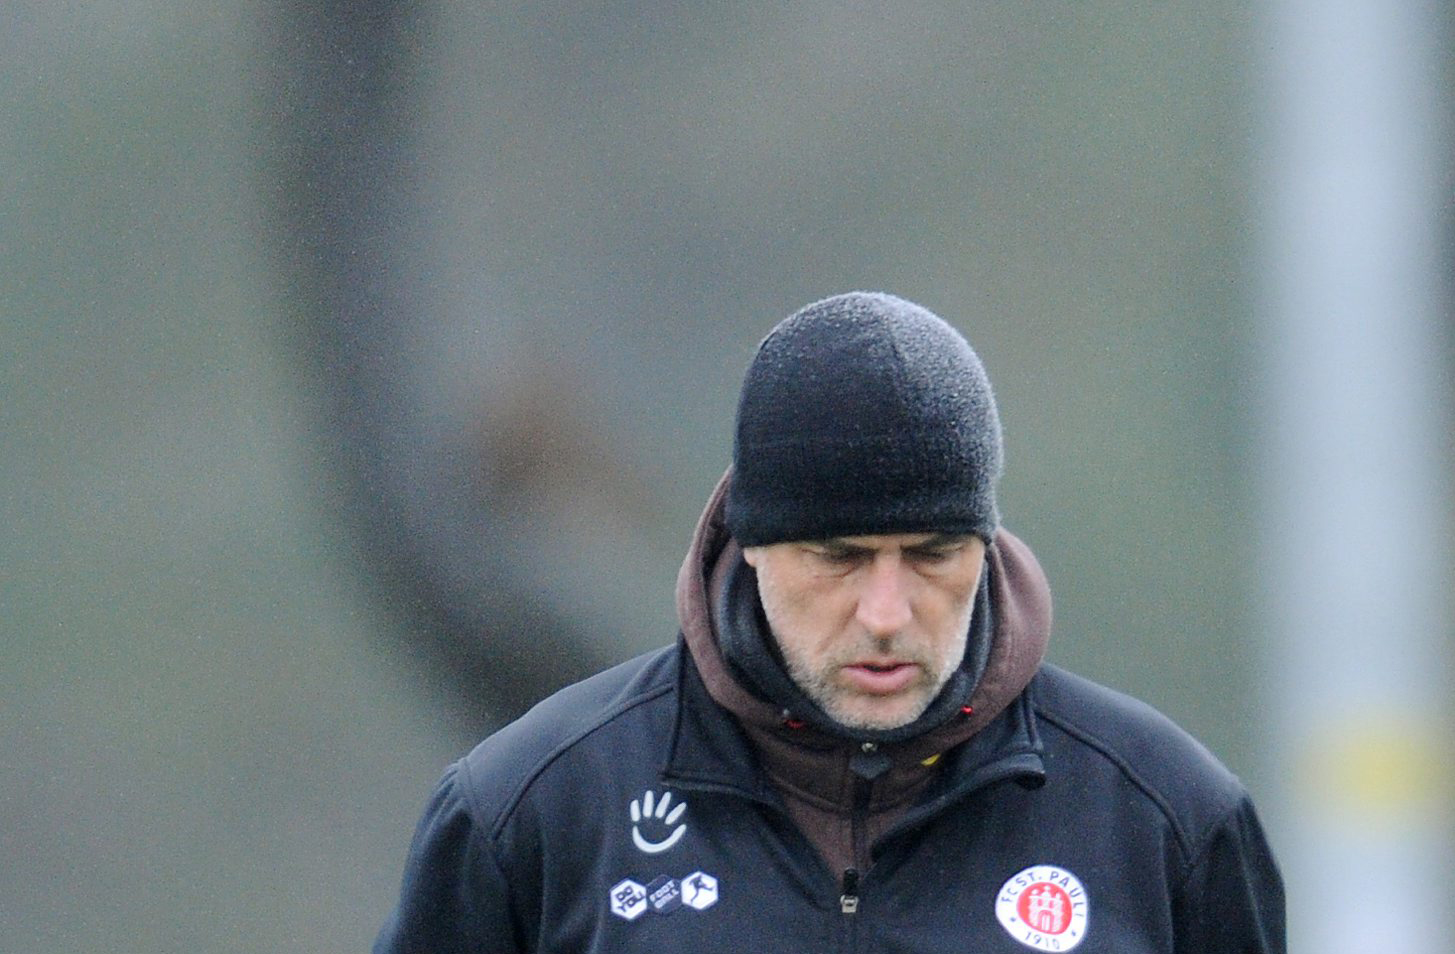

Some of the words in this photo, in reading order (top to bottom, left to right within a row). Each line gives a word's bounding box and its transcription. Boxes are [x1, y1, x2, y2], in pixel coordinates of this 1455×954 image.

[615, 885, 634, 903] DO
[1001, 887, 1018, 903] FC
[1049, 871, 1085, 918] PAULI
[1024, 931, 1061, 950] 1910
